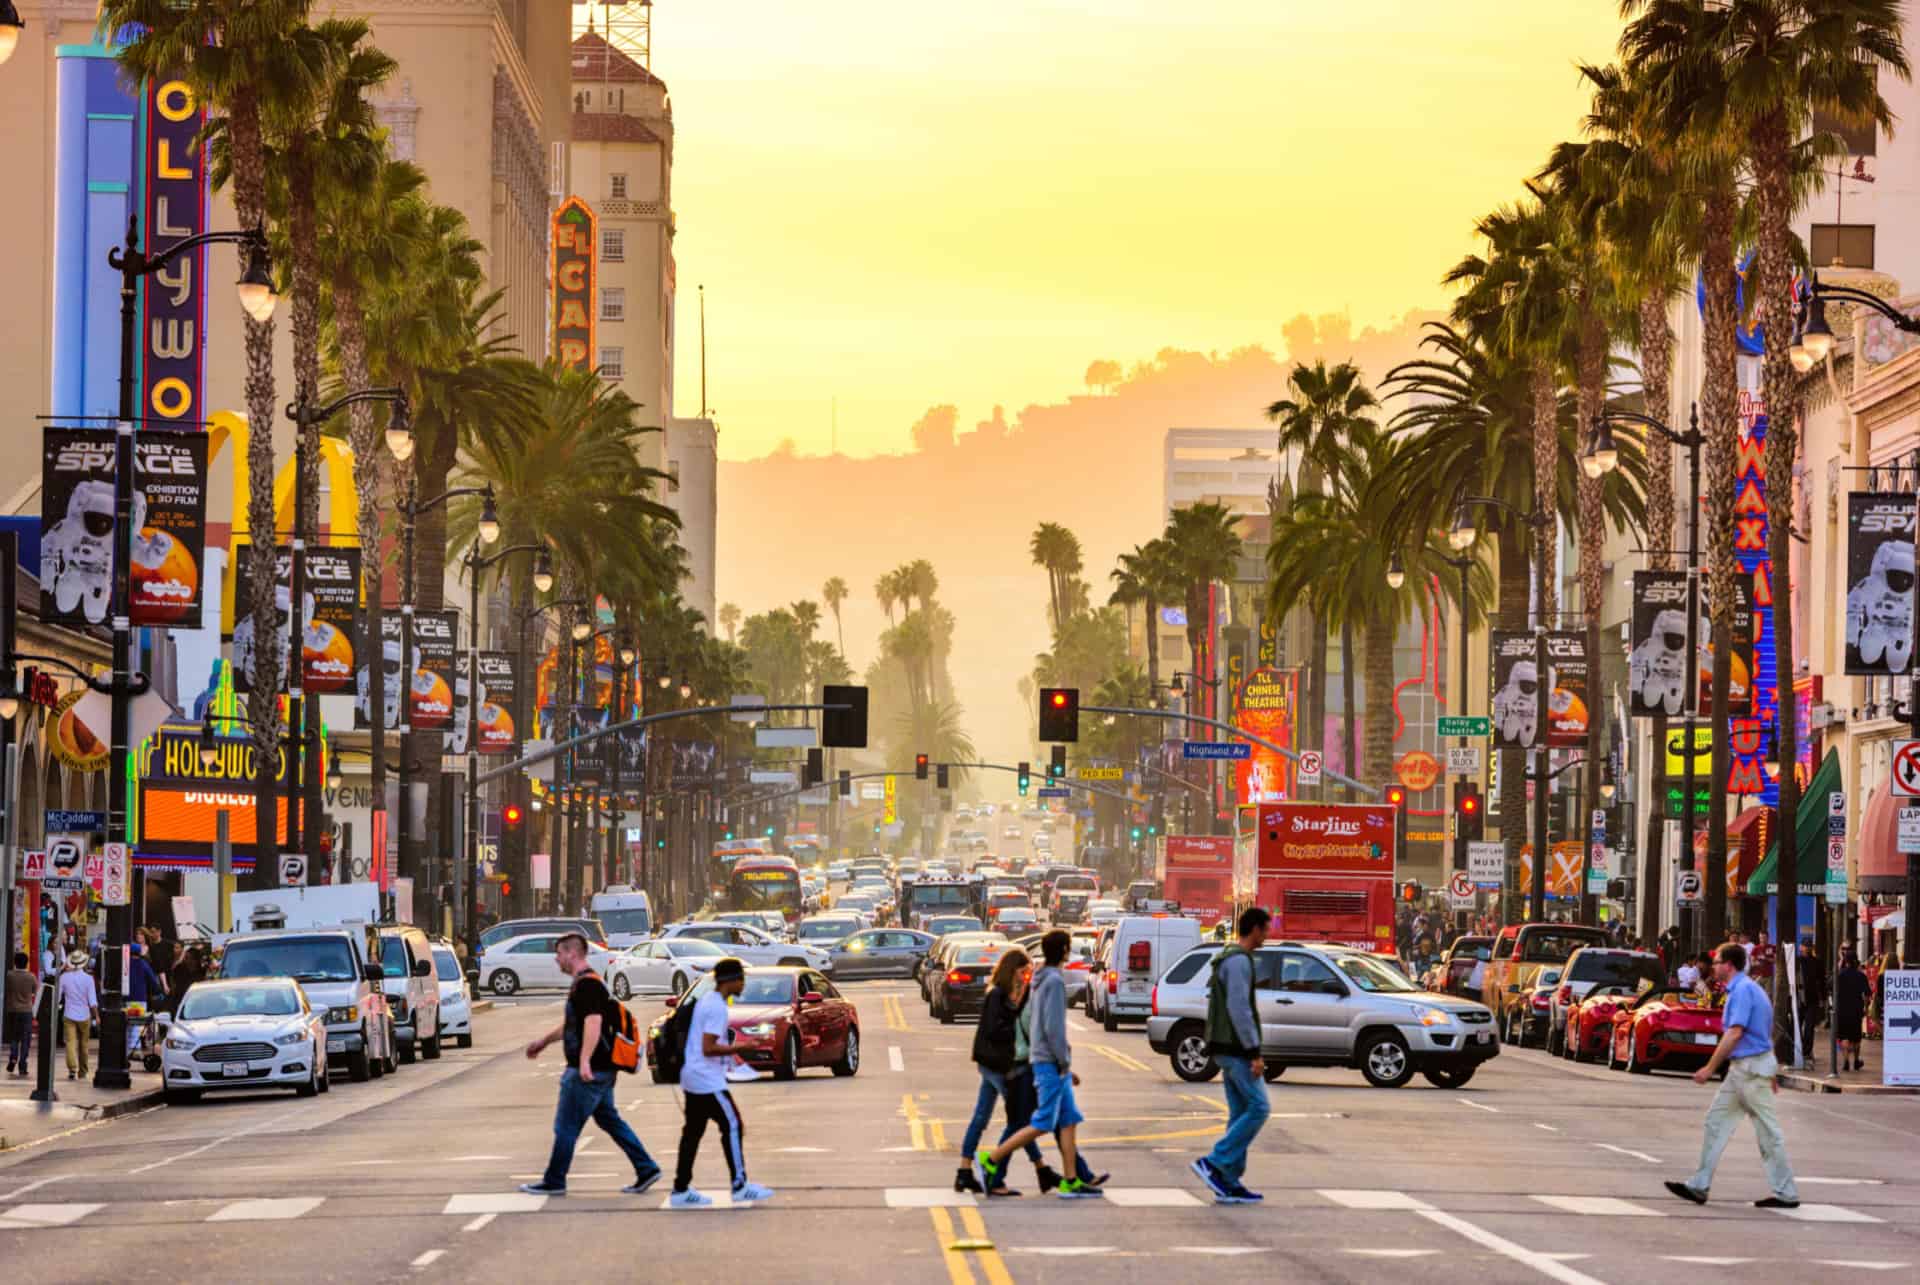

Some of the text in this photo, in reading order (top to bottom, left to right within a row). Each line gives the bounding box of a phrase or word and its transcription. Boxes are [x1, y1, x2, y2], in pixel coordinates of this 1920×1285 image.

[558, 224, 590, 255] EL
[1735, 430, 1768, 550] WAX
[174, 497, 197, 505] FILM
[1189, 744, 1230, 756] Highland
[47, 812, 95, 823] McCadden
[1886, 977, 1920, 988] PUBLI
[1886, 991, 1920, 1001] PARKIN
